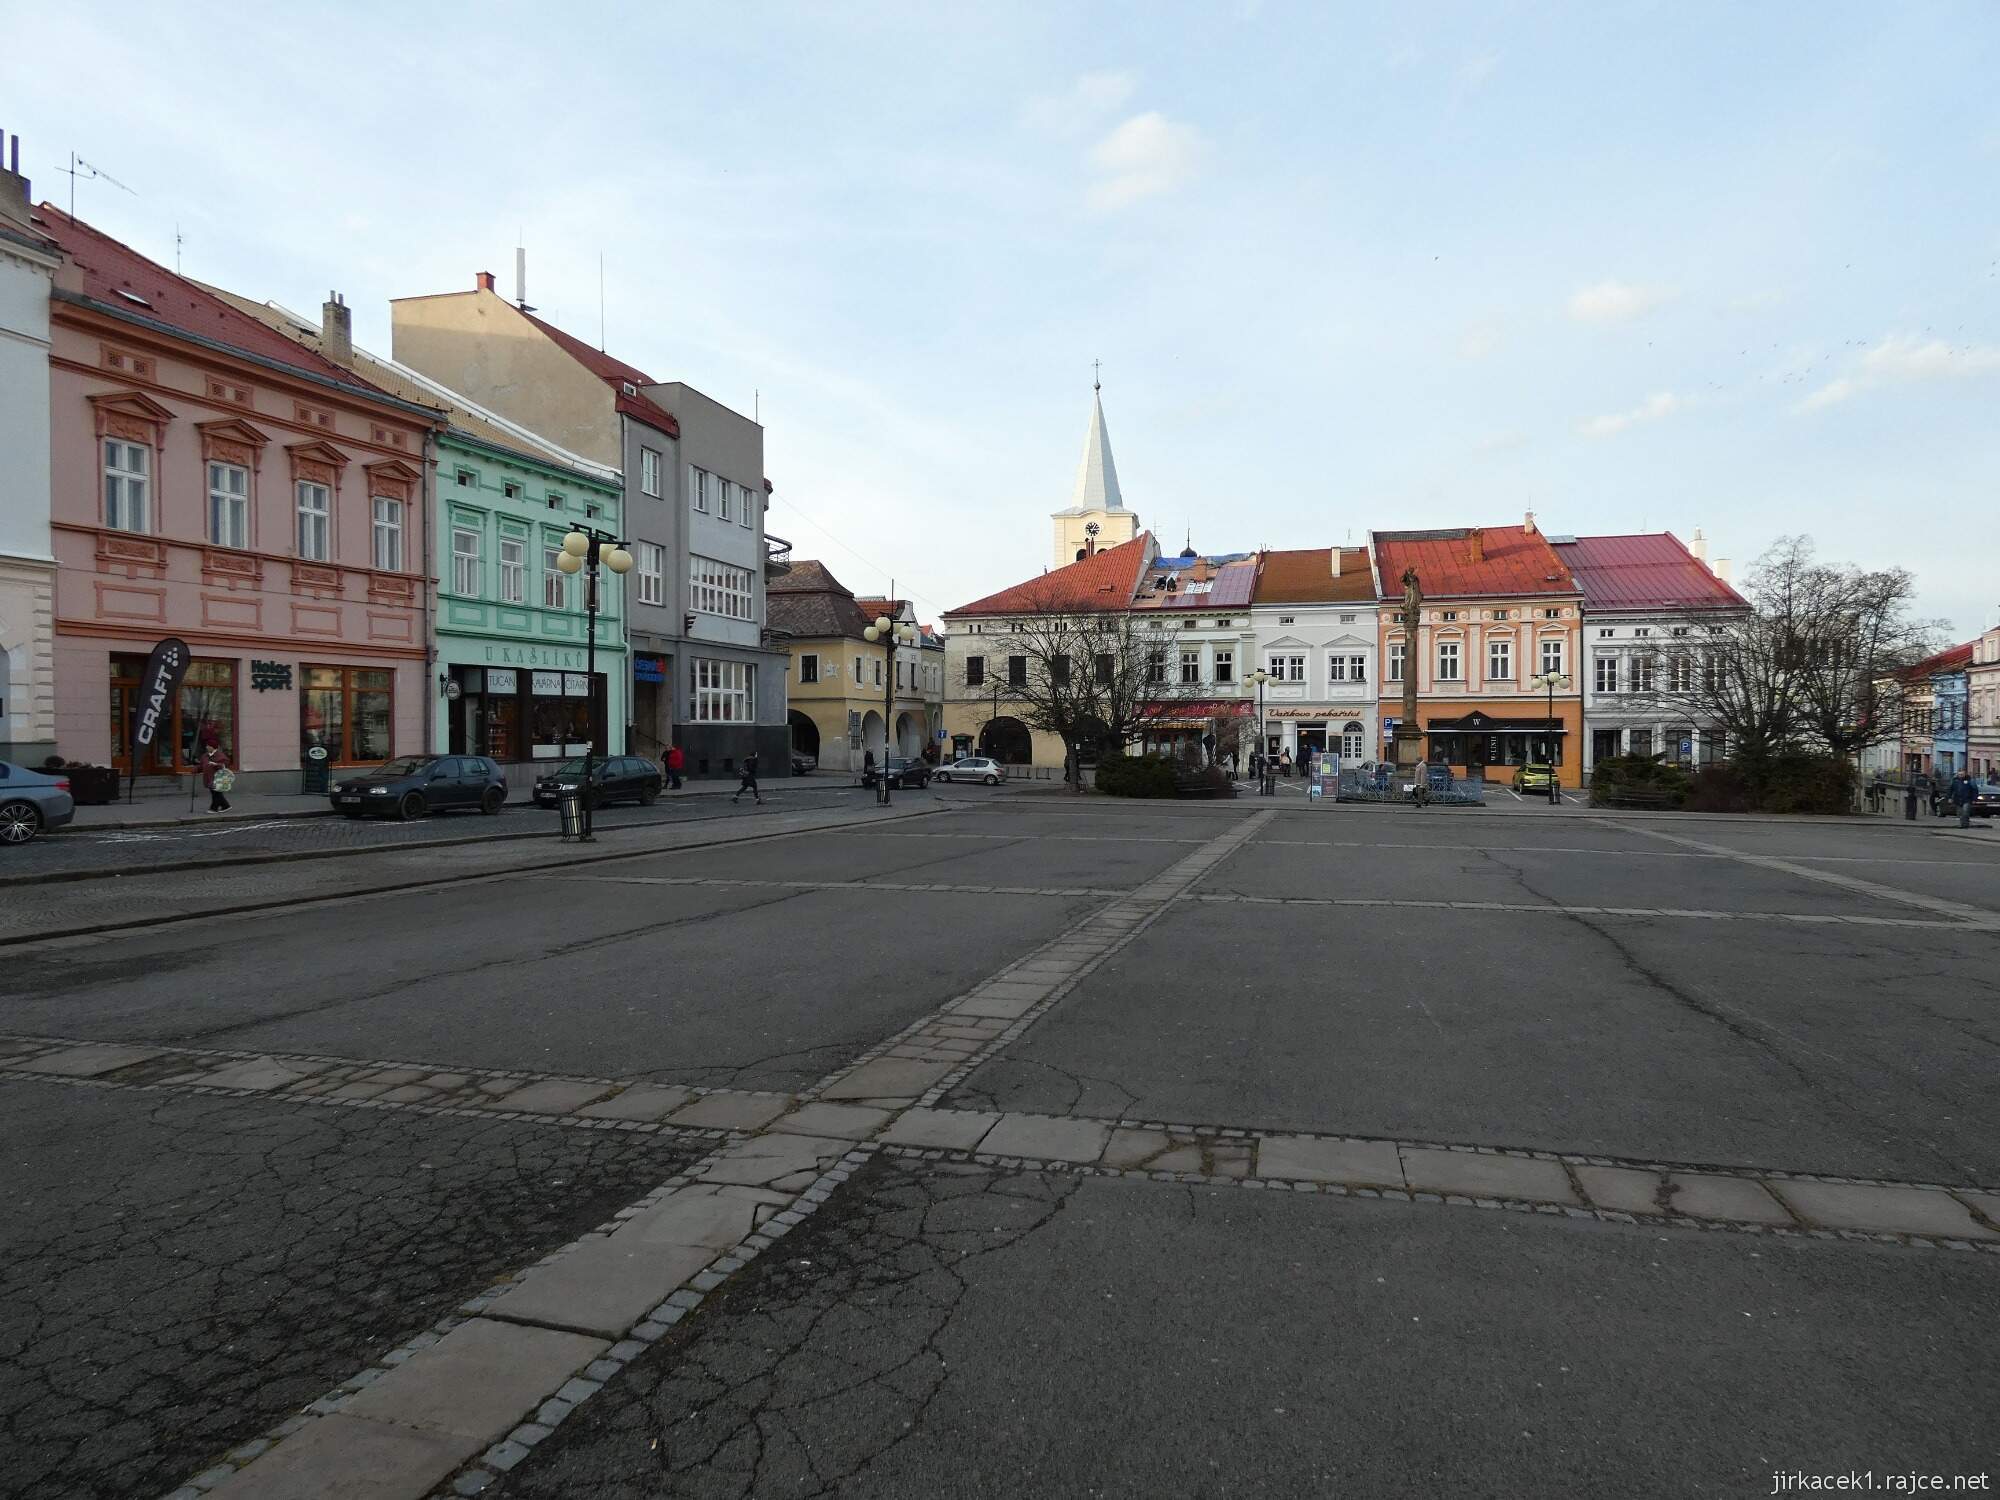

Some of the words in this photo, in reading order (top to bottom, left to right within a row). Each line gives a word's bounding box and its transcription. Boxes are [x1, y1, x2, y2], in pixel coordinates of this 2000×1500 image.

[485, 646, 493, 661] U
[138, 664, 173, 745] CRAFT
[1472, 718, 1481, 726] W
